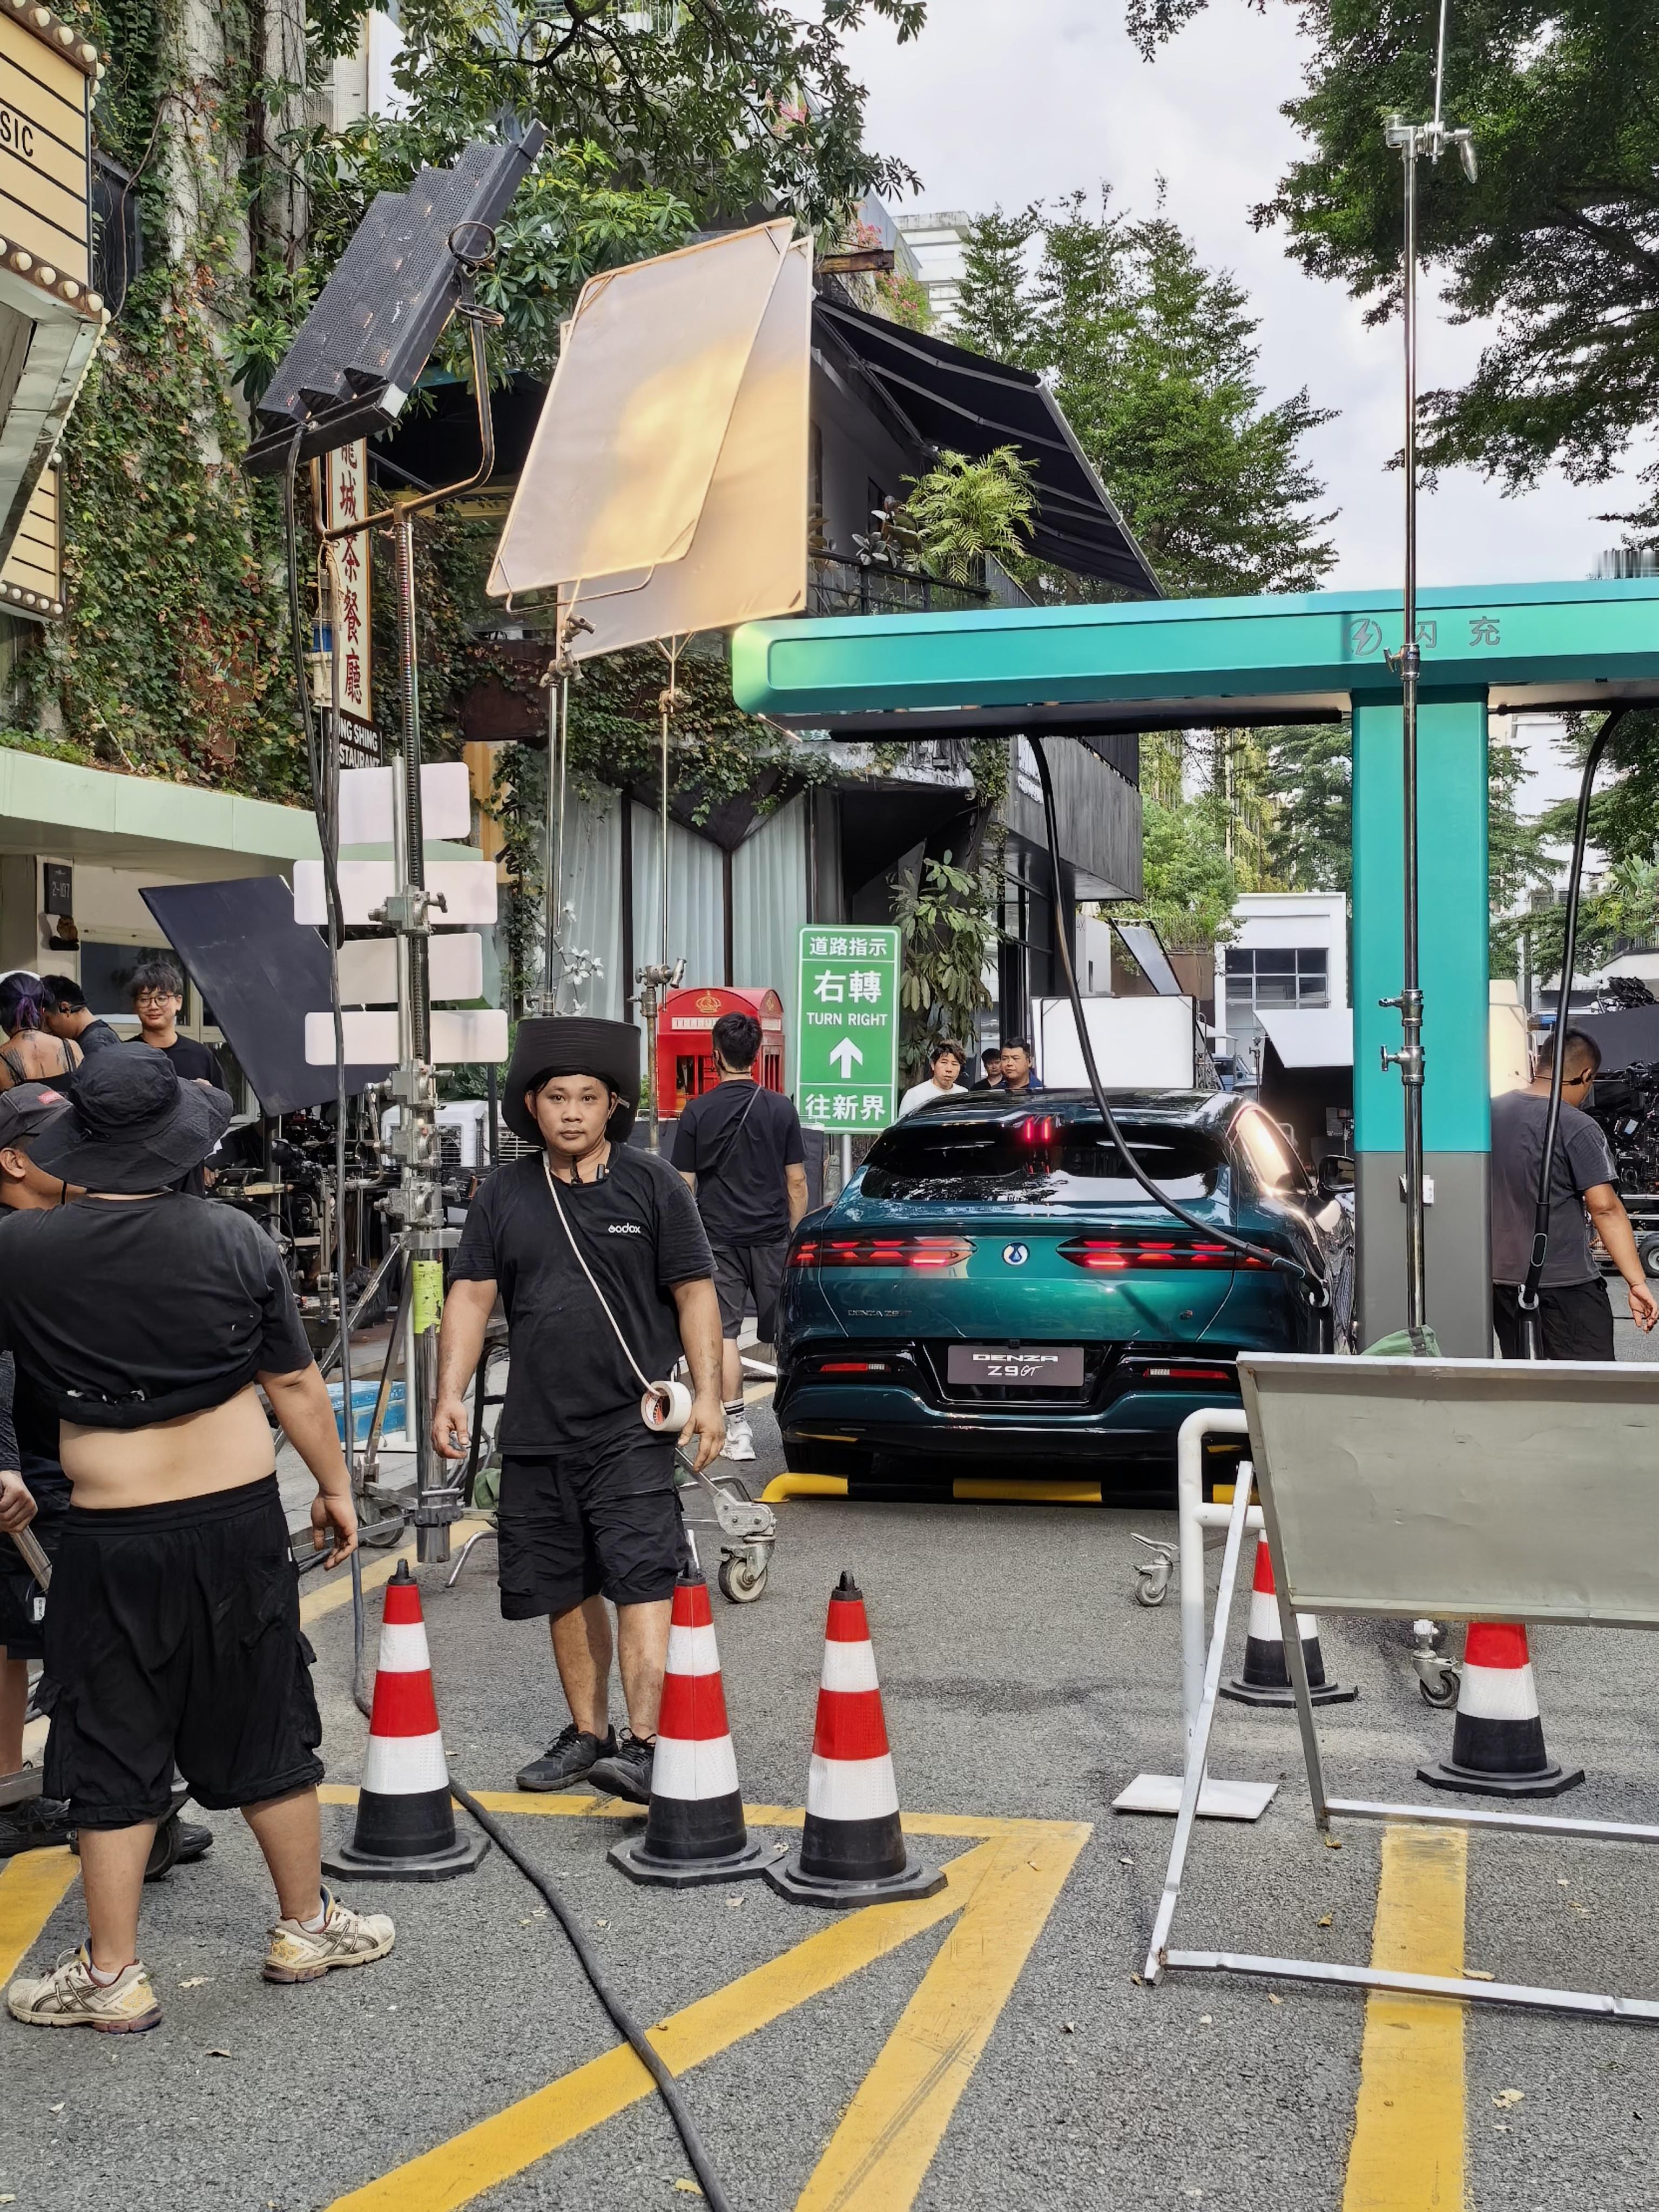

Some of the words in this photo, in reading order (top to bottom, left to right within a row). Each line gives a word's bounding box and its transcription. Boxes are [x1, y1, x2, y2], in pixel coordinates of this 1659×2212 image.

[354, 724, 378, 752] SHING
[809, 936, 887, 957] 道路指示
[813, 969, 882, 1004] 右轉
[806, 1012, 842, 1026] TURN
[848, 1013, 888, 1026] RIGHT
[805, 1094, 886, 1121] 往新界
[972, 1354, 1058, 1362] DENZA
